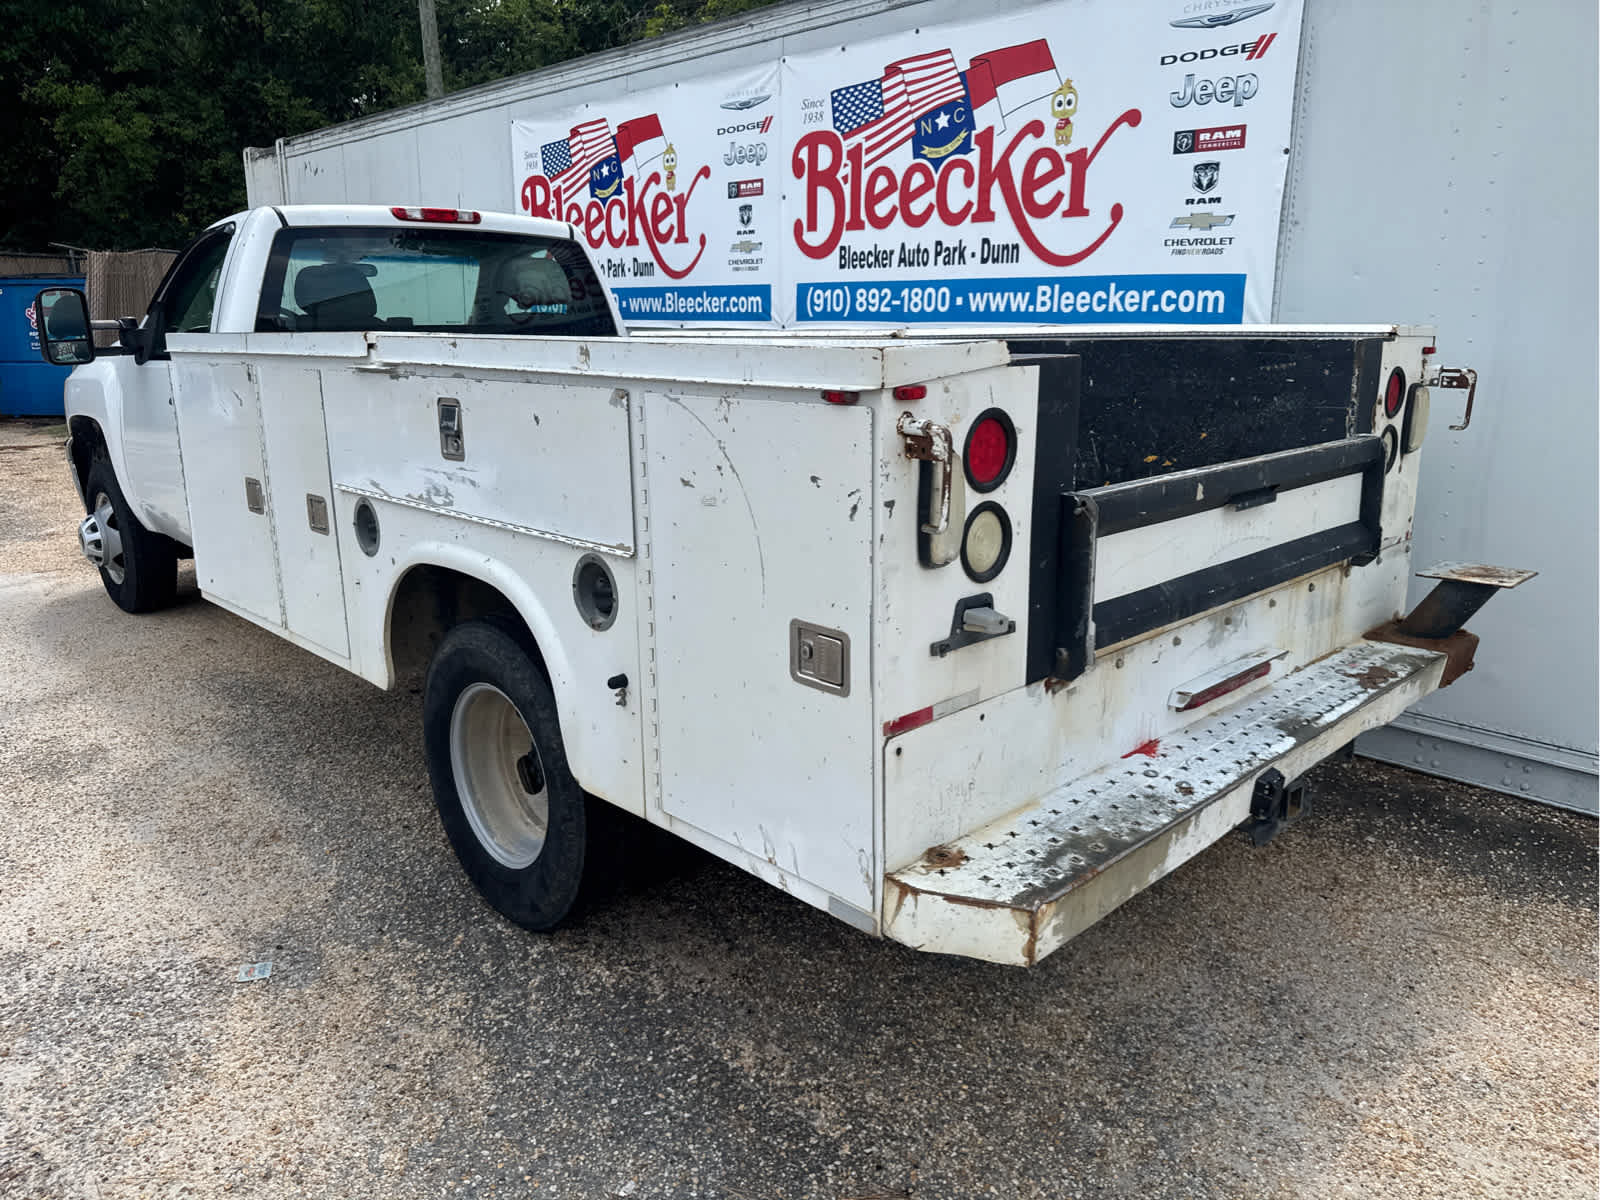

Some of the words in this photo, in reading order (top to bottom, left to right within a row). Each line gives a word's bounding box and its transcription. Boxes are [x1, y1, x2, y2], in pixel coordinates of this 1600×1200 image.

[1160, 41, 1260, 66] DODGE
[1169, 73, 1259, 109] Jeep
[801, 98, 825, 110] Since
[803, 110, 825, 125] 1938
[920, 118, 932, 137] N
[953, 107, 966, 124] C
[717, 121, 765, 135] DODGE
[1199, 129, 1242, 141] RAM
[723, 141, 768, 167] Jeep
[740, 182, 761, 190] RAM
[1185, 196, 1222, 206] RAM
[1163, 236, 1235, 247] CHEVROLET
[728, 258, 763, 266] CHEVROLET
[838, 243, 894, 270] Bleecker
[897, 241, 929, 268] Auto
[933, 238, 967, 267] Park
[980, 236, 1020, 265] Dunn
[607, 257, 626, 279] Park
[632, 256, 655, 278] Dunn
[628, 291, 763, 313] www.Bleecker.com
[806, 286, 851, 317] (910)
[855, 285, 949, 313] 892-1800
[969, 282, 1225, 314] www.Bleecker.com
